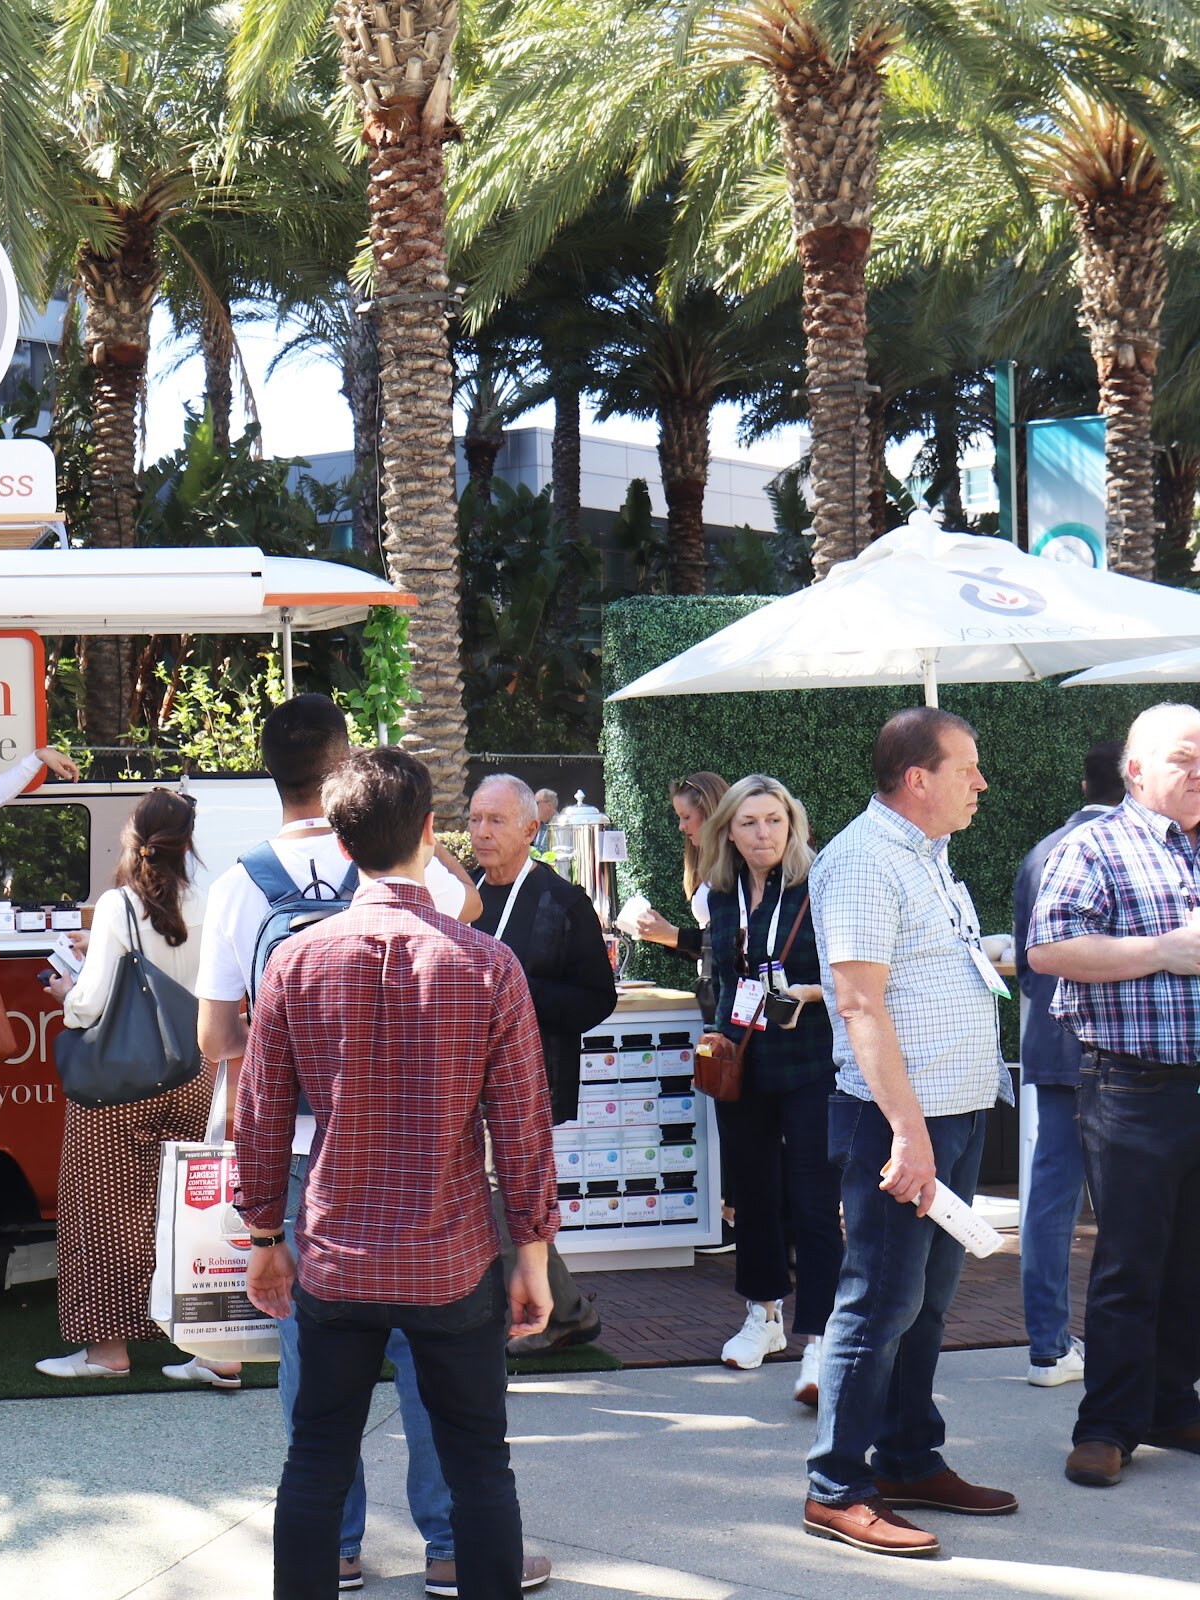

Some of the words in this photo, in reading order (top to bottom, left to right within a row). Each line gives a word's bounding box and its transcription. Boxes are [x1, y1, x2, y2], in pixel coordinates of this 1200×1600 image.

[944, 622, 1127, 642] youtheor
[189, 1171, 218, 1179] LARGEST
[208, 1257, 246, 1266] Robinson
[192, 1281, 247, 1289] WWW.ROBINSO
